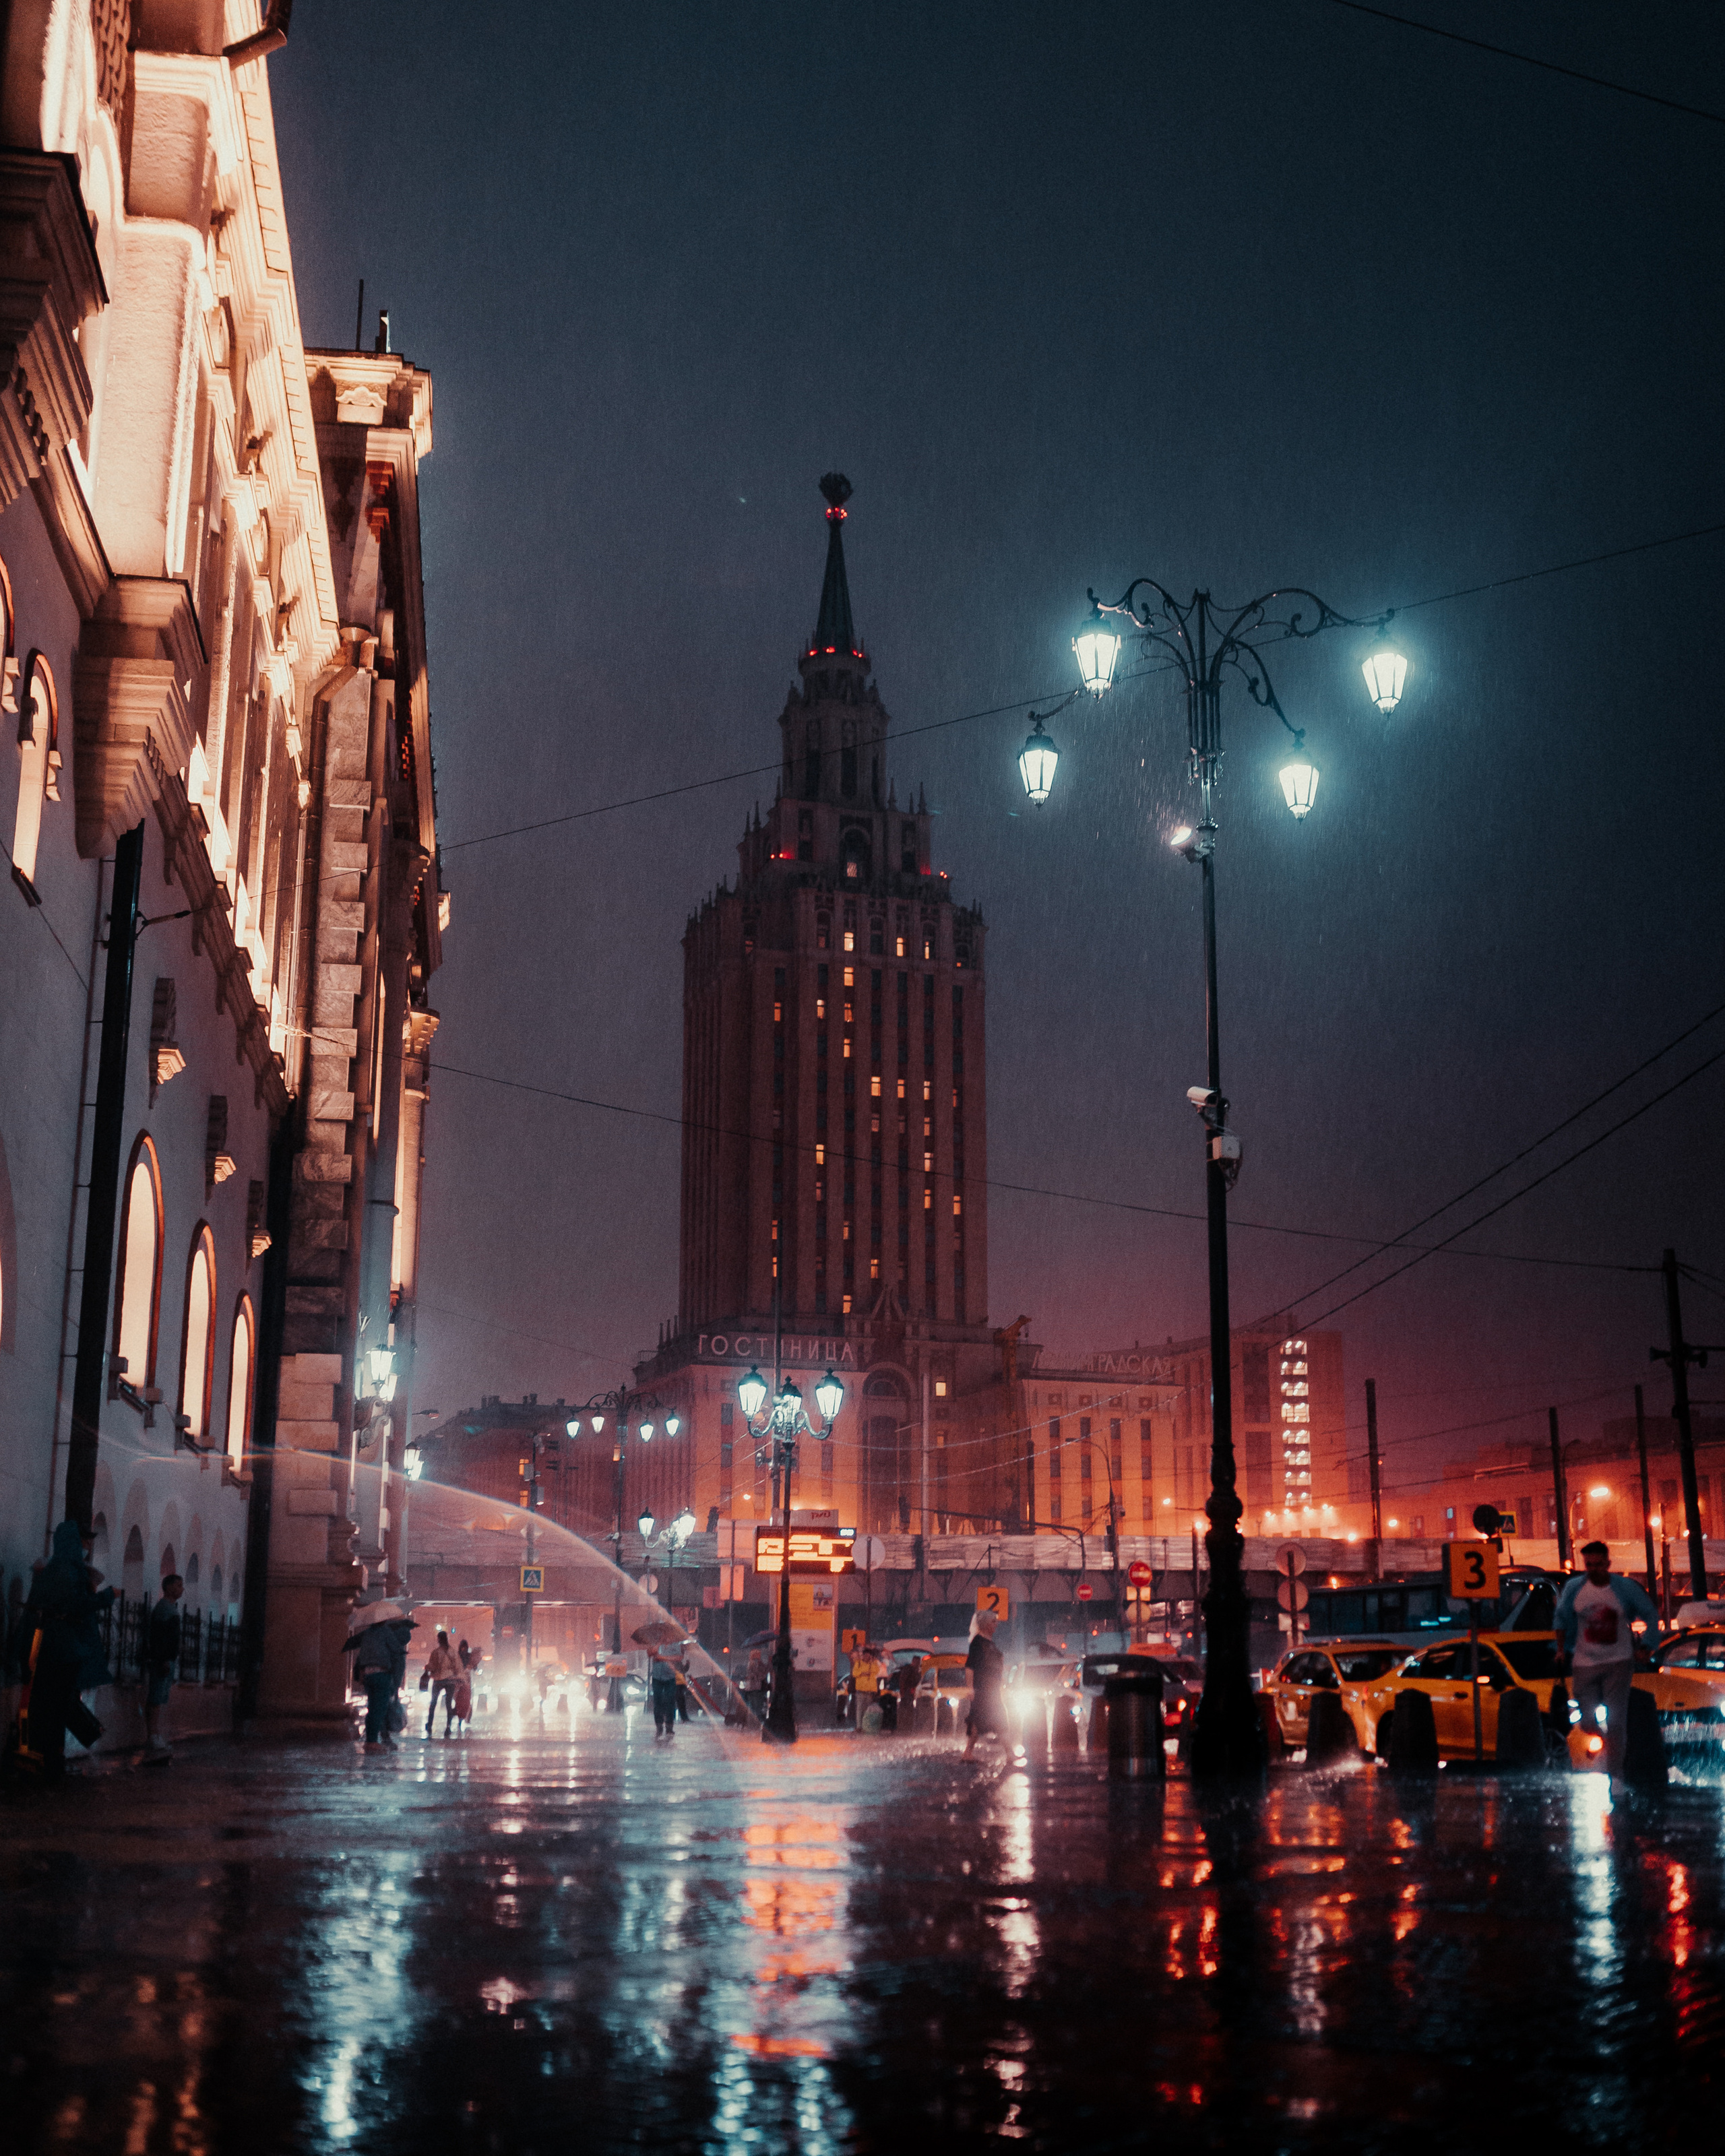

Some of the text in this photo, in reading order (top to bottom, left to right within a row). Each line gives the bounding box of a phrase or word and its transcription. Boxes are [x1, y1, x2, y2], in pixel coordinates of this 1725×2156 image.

[1464, 1551, 1486, 1589] 3
[987, 1593, 999, 1613] 2
[851, 1634, 858, 1651] 1
